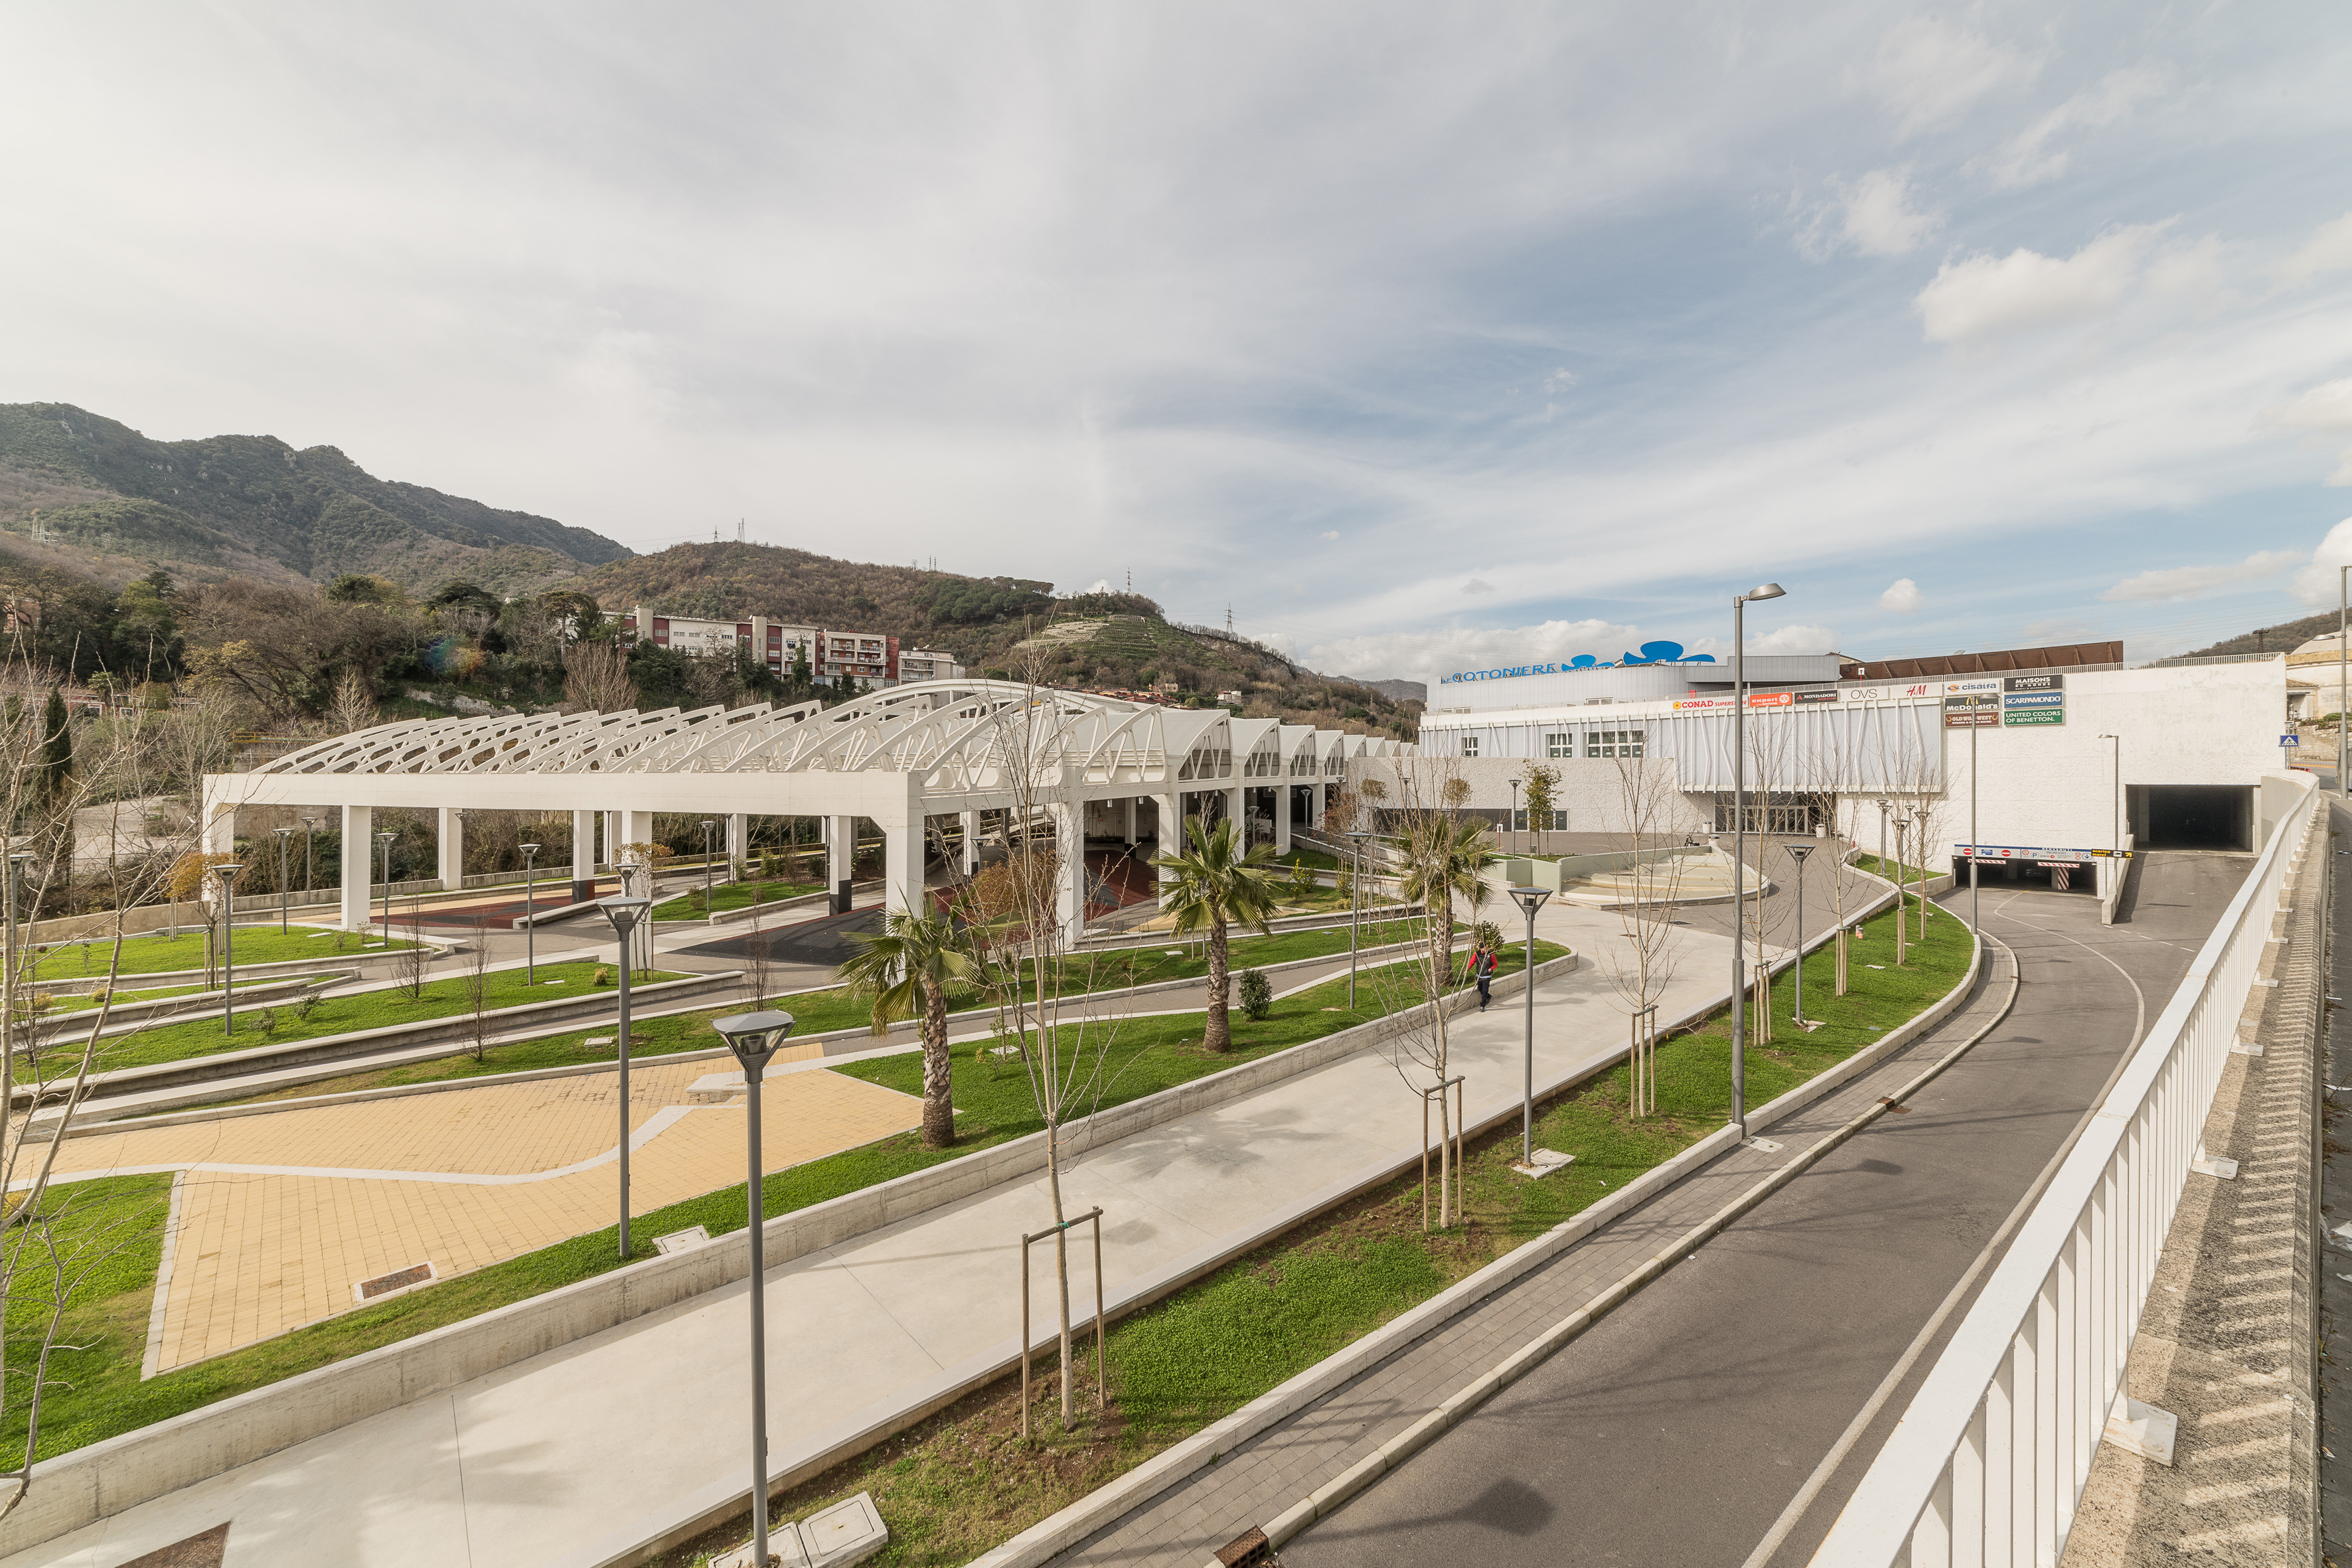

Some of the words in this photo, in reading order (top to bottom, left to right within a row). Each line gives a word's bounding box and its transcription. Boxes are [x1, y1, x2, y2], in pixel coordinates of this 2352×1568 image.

[1452, 663, 1557, 682] COTONIERE
[1851, 688, 1877, 700] OVS
[1907, 684, 1926, 696] H&M
[2005, 696, 2061, 704] SCARPAMONDO
